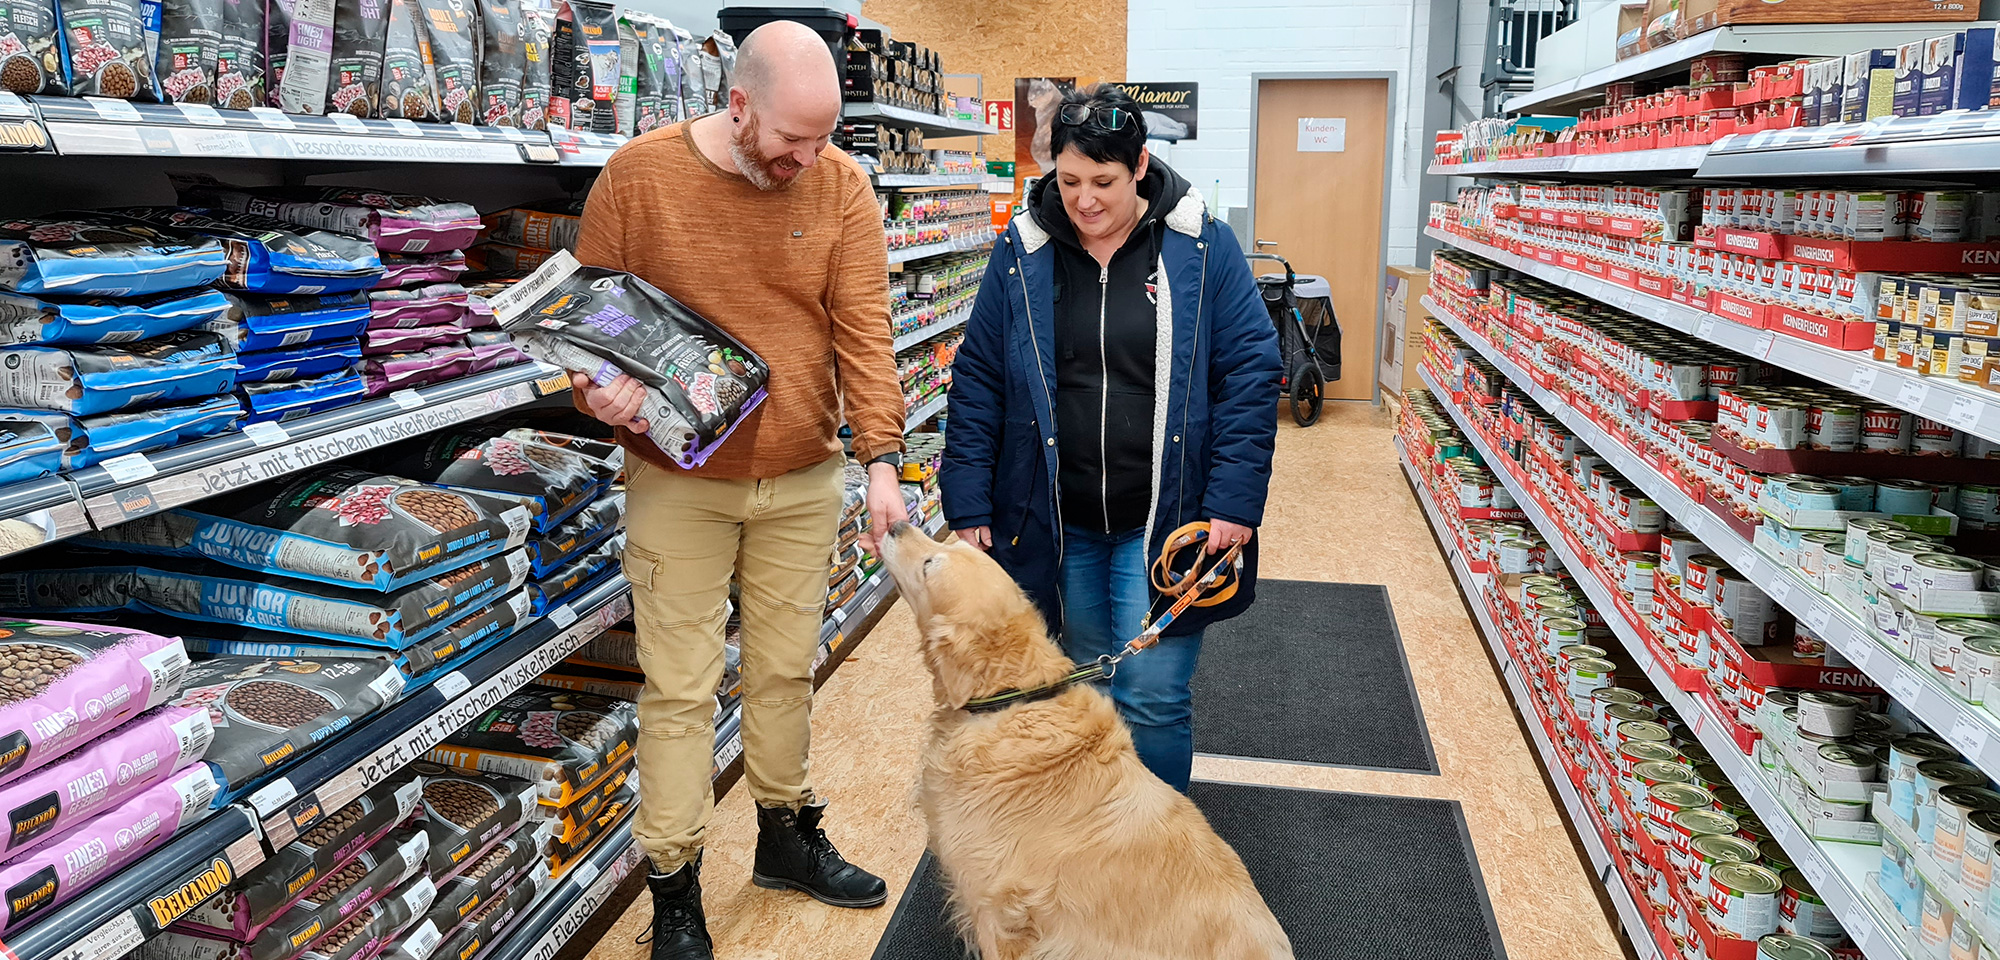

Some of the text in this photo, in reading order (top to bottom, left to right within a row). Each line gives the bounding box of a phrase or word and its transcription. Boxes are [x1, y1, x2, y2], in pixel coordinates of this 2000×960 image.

[13, 14, 38, 27] FLEISCH
[428, 8, 452, 22] ADULT
[108, 23, 131, 36] LAMM
[297, 22, 324, 38] FINEST
[297, 36, 322, 48] LIGHT
[1114, 82, 1191, 104] Miamor
[294, 137, 486, 161] besonders schonend hergestellt
[1314, 136, 1328, 144] WC
[1726, 234, 1759, 250] KENNERFLEISCH
[1793, 244, 1834, 263] KENNERFLEISCH
[510, 288, 531, 304] SUPER
[528, 274, 548, 293] PREMIUM
[1720, 300, 1753, 319] KENNERFLEISCH
[1982, 312, 1996, 321] DOG
[1782, 313, 1829, 338] KENNERFLEISCH
[678, 350, 702, 370] FLEISCH
[1970, 357, 1982, 366] DOG
[1864, 416, 1904, 431] RINTI
[198, 404, 465, 495] Jetzt mit frischem Muskelfleisch
[200, 522, 280, 553] JUNIOR
[198, 540, 272, 568] LAMB & RICE
[208, 583, 286, 615] JUNIOR
[208, 604, 286, 628] LAMB & RICE
[102, 684, 130, 705] NO GRAIN
[357, 631, 581, 789] Jetzt mit frischem Muskelfleisch
[32, 706, 79, 740] FINEST
[308, 721, 334, 744] PUPPY
[131, 750, 158, 771] NO GRAIN
[262, 744, 295, 767] BELCANDO
[67, 768, 109, 803] FINEST
[15, 806, 56, 834] BELCANDO
[131, 810, 160, 834] NO GRAIN
[294, 806, 320, 828] BELCANDO
[64, 837, 109, 873] FINEST
[288, 868, 316, 893] BELCANDO
[14, 880, 56, 915] BELCANDO
[149, 858, 233, 930] BELCANDO
[86, 916, 126, 945] Vergleichbar
[552, 895, 599, 945] Fleisch
[291, 922, 322, 946] BELCANDO
[94, 942, 111, 956] garen
